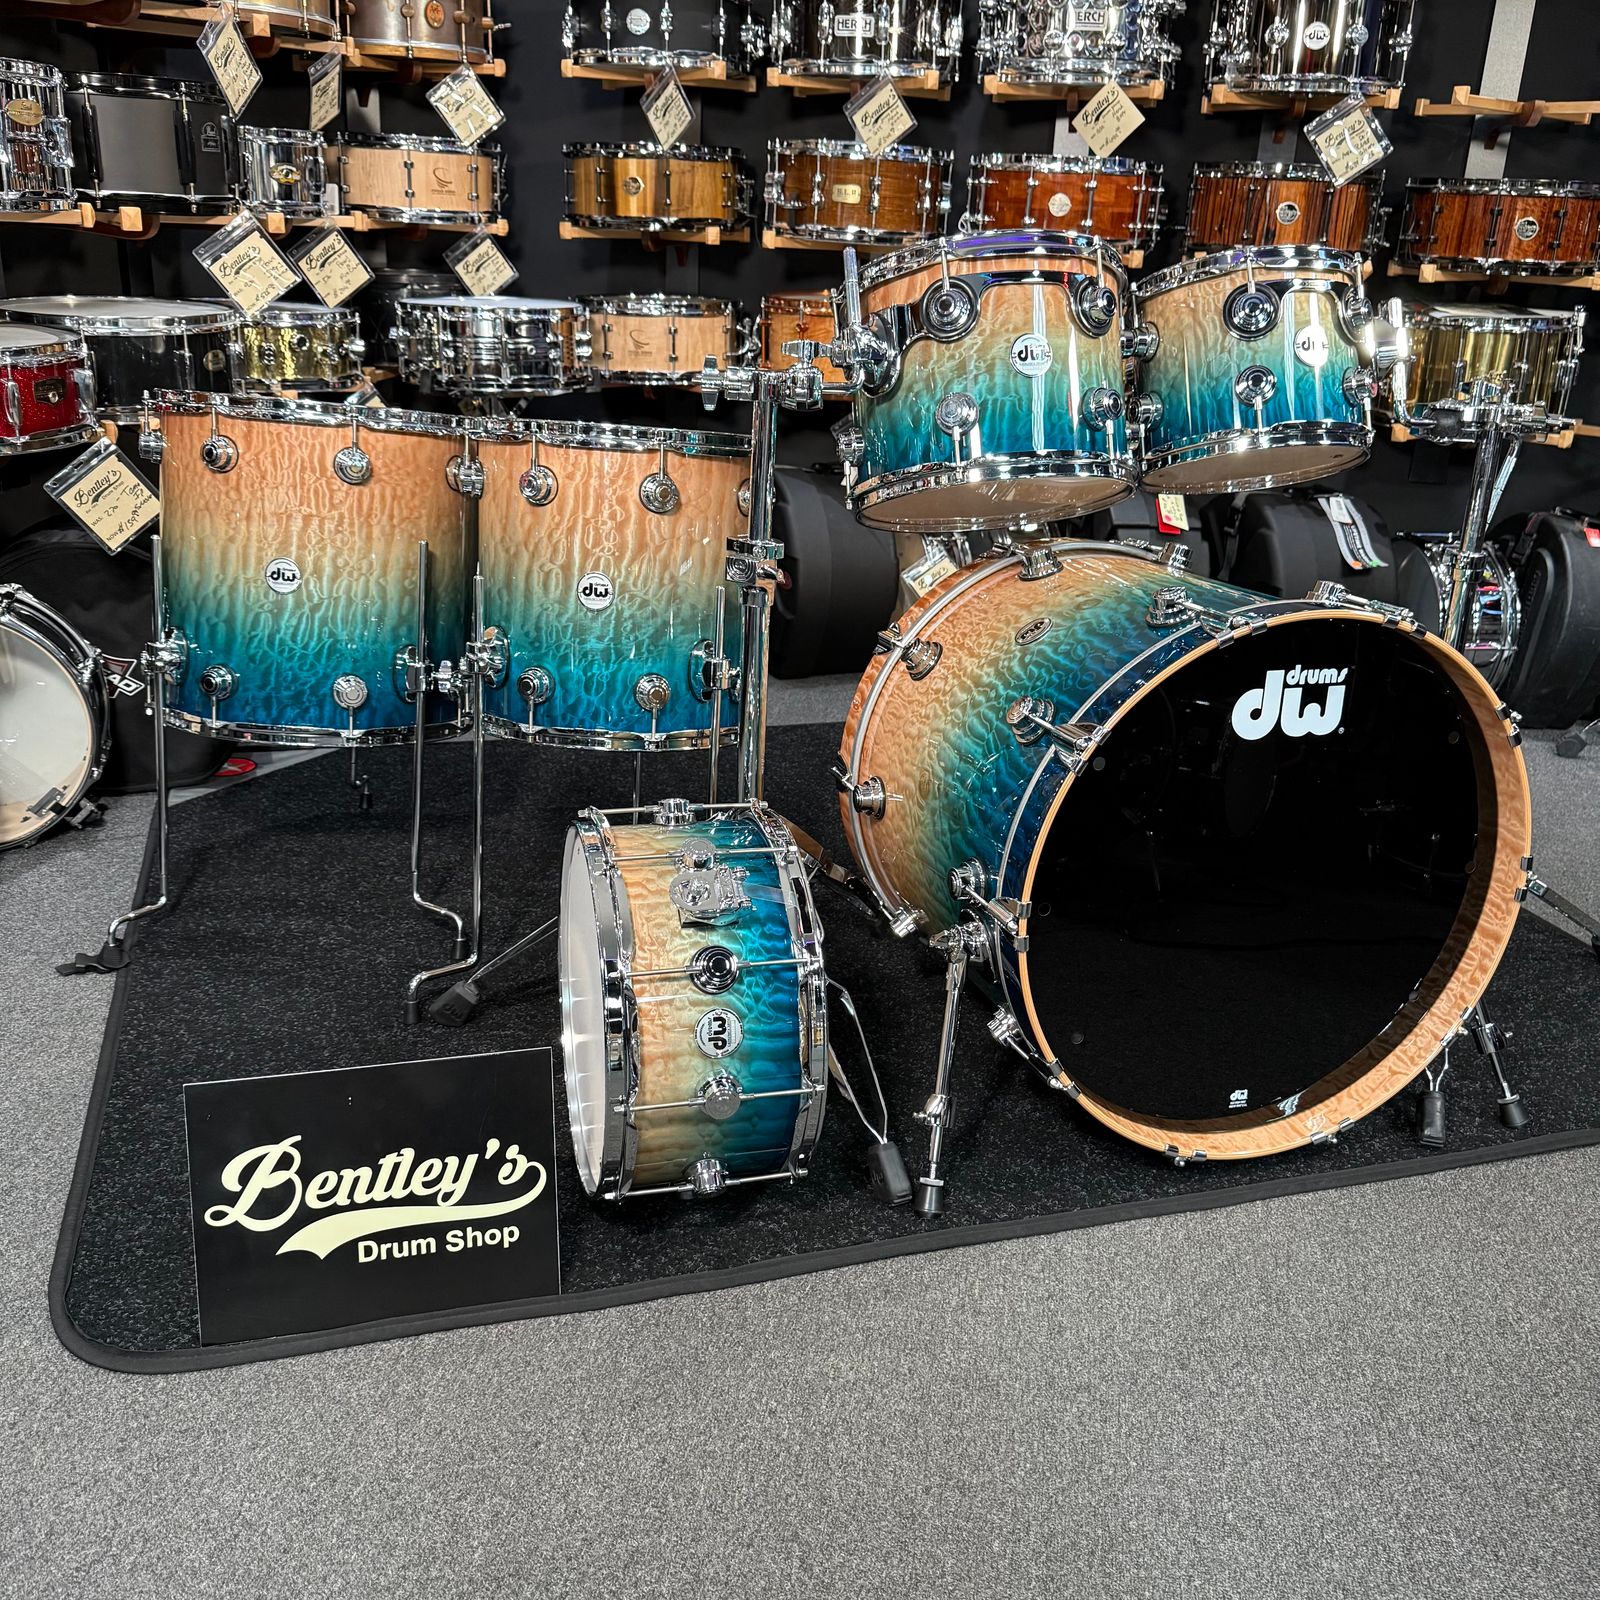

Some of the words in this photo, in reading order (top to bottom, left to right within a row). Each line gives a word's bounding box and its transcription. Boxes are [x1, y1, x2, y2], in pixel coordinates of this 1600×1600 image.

[837, 18, 872, 31] HERH
[1077, 11, 1105, 24] ERCH
[1308, 29, 1326, 40] dw
[860, 93, 896, 127] Bentley's
[1081, 89, 1117, 126] Bentley's
[1324, 120, 1362, 148] Bentey's
[219, 244, 259, 279] Bentley's
[304, 237, 342, 272] Bentley's
[462, 245, 495, 274] Bentley's
[74, 469, 119, 508] Bentley's
[270, 567, 296, 582] dw
[582, 582, 609, 598] dw
[1285, 664, 1349, 685] drums
[1231, 669, 1346, 741] dw
[707, 1016, 728, 1051] dw
[204, 1135, 528, 1232] Bentley's
[357, 1236, 436, 1263] Drum
[445, 1225, 520, 1252] Shop
